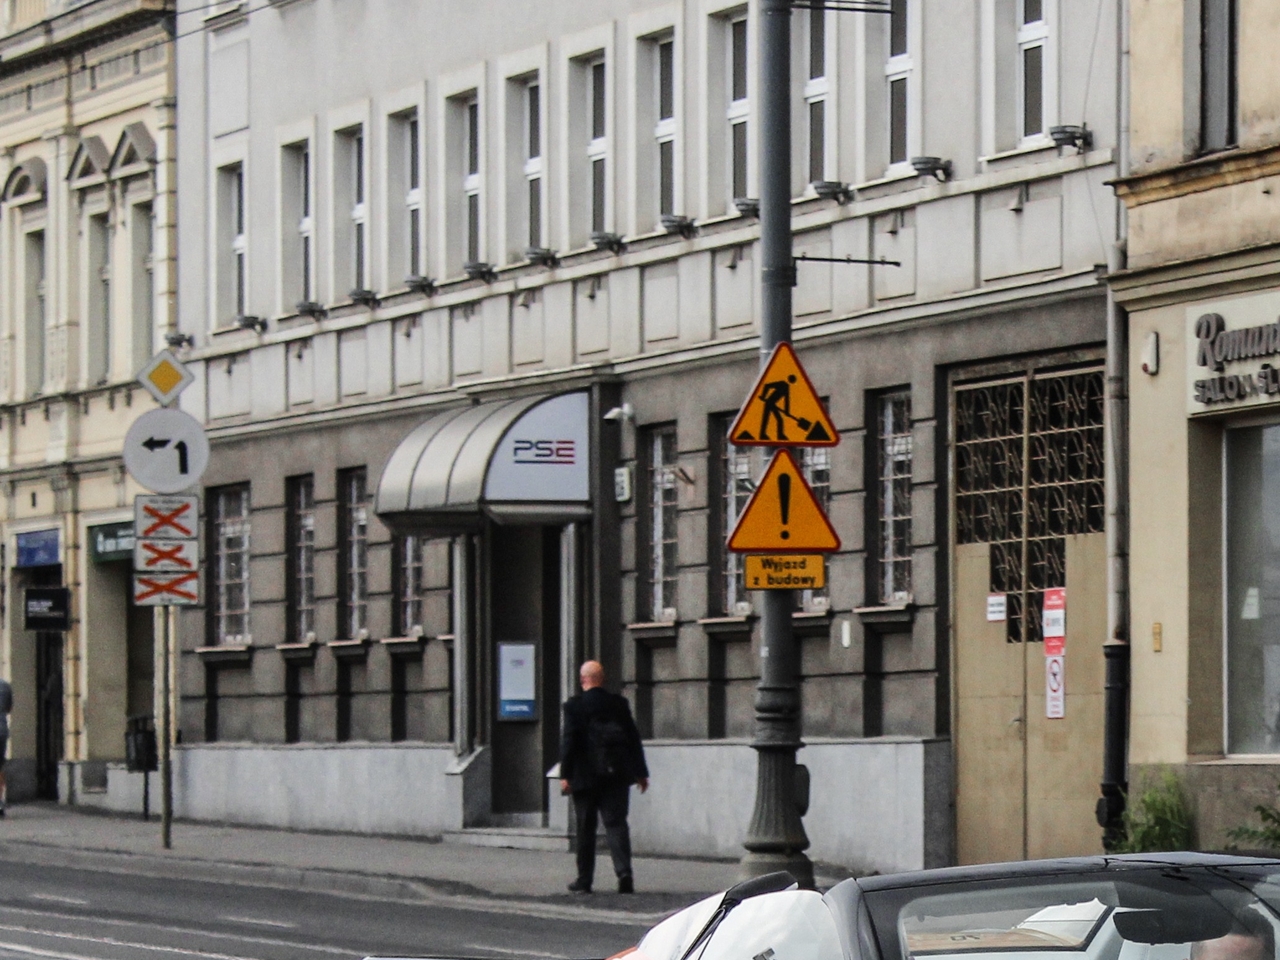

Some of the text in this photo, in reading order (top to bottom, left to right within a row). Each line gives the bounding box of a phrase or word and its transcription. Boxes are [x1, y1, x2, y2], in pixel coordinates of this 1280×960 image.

[1194, 373, 1258, 405] SALON
[513, 440, 576, 458] PSE
[761, 558, 807, 572] Wyjazd
[753, 574, 816, 588] z budowy
